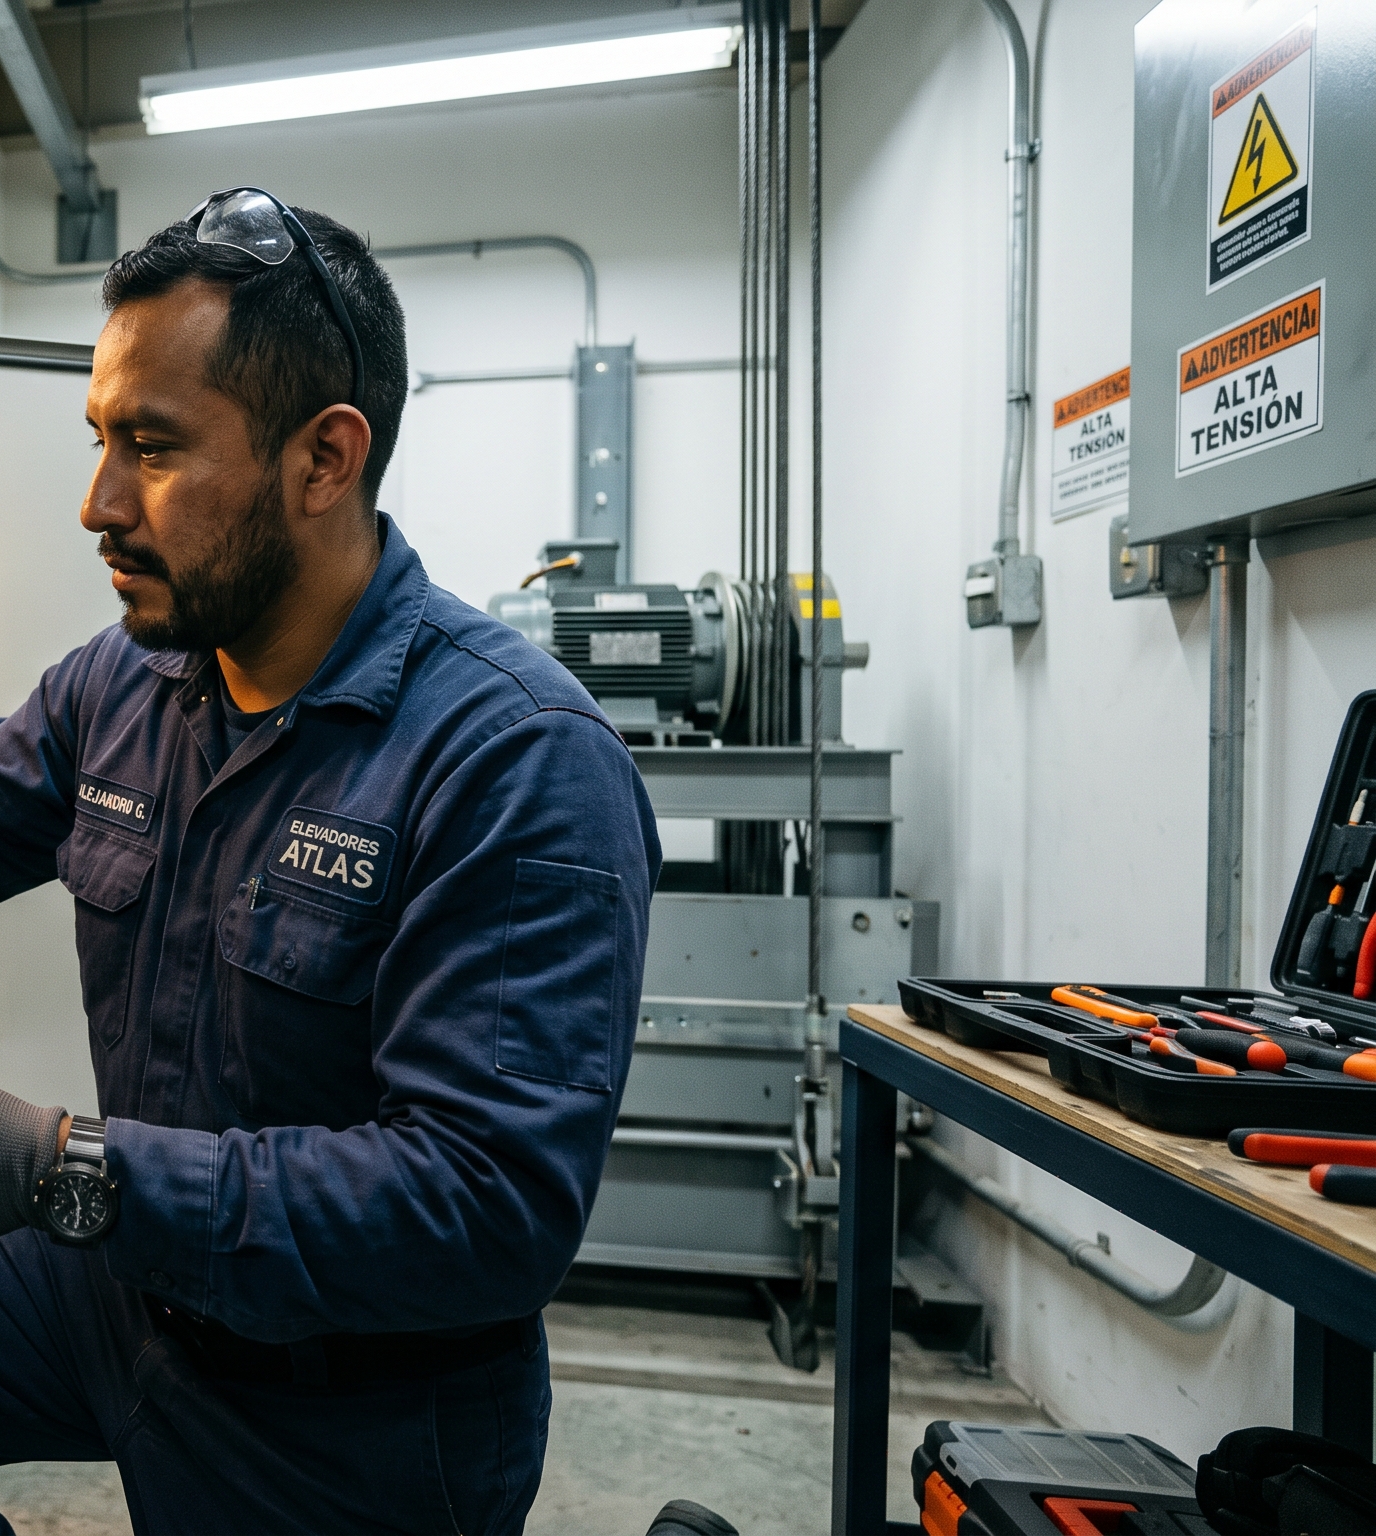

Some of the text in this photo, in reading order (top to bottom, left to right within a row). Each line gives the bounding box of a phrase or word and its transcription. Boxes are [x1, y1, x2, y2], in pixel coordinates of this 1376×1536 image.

[1214, 365, 1278, 414] ALTA
[1081, 412, 1112, 437] ALTA
[1191, 391, 1303, 455] TENSIÓN
[135, 803, 145, 819] G.
[289, 819, 380, 857] ELEVADORES
[279, 840, 375, 890] ATLAS
